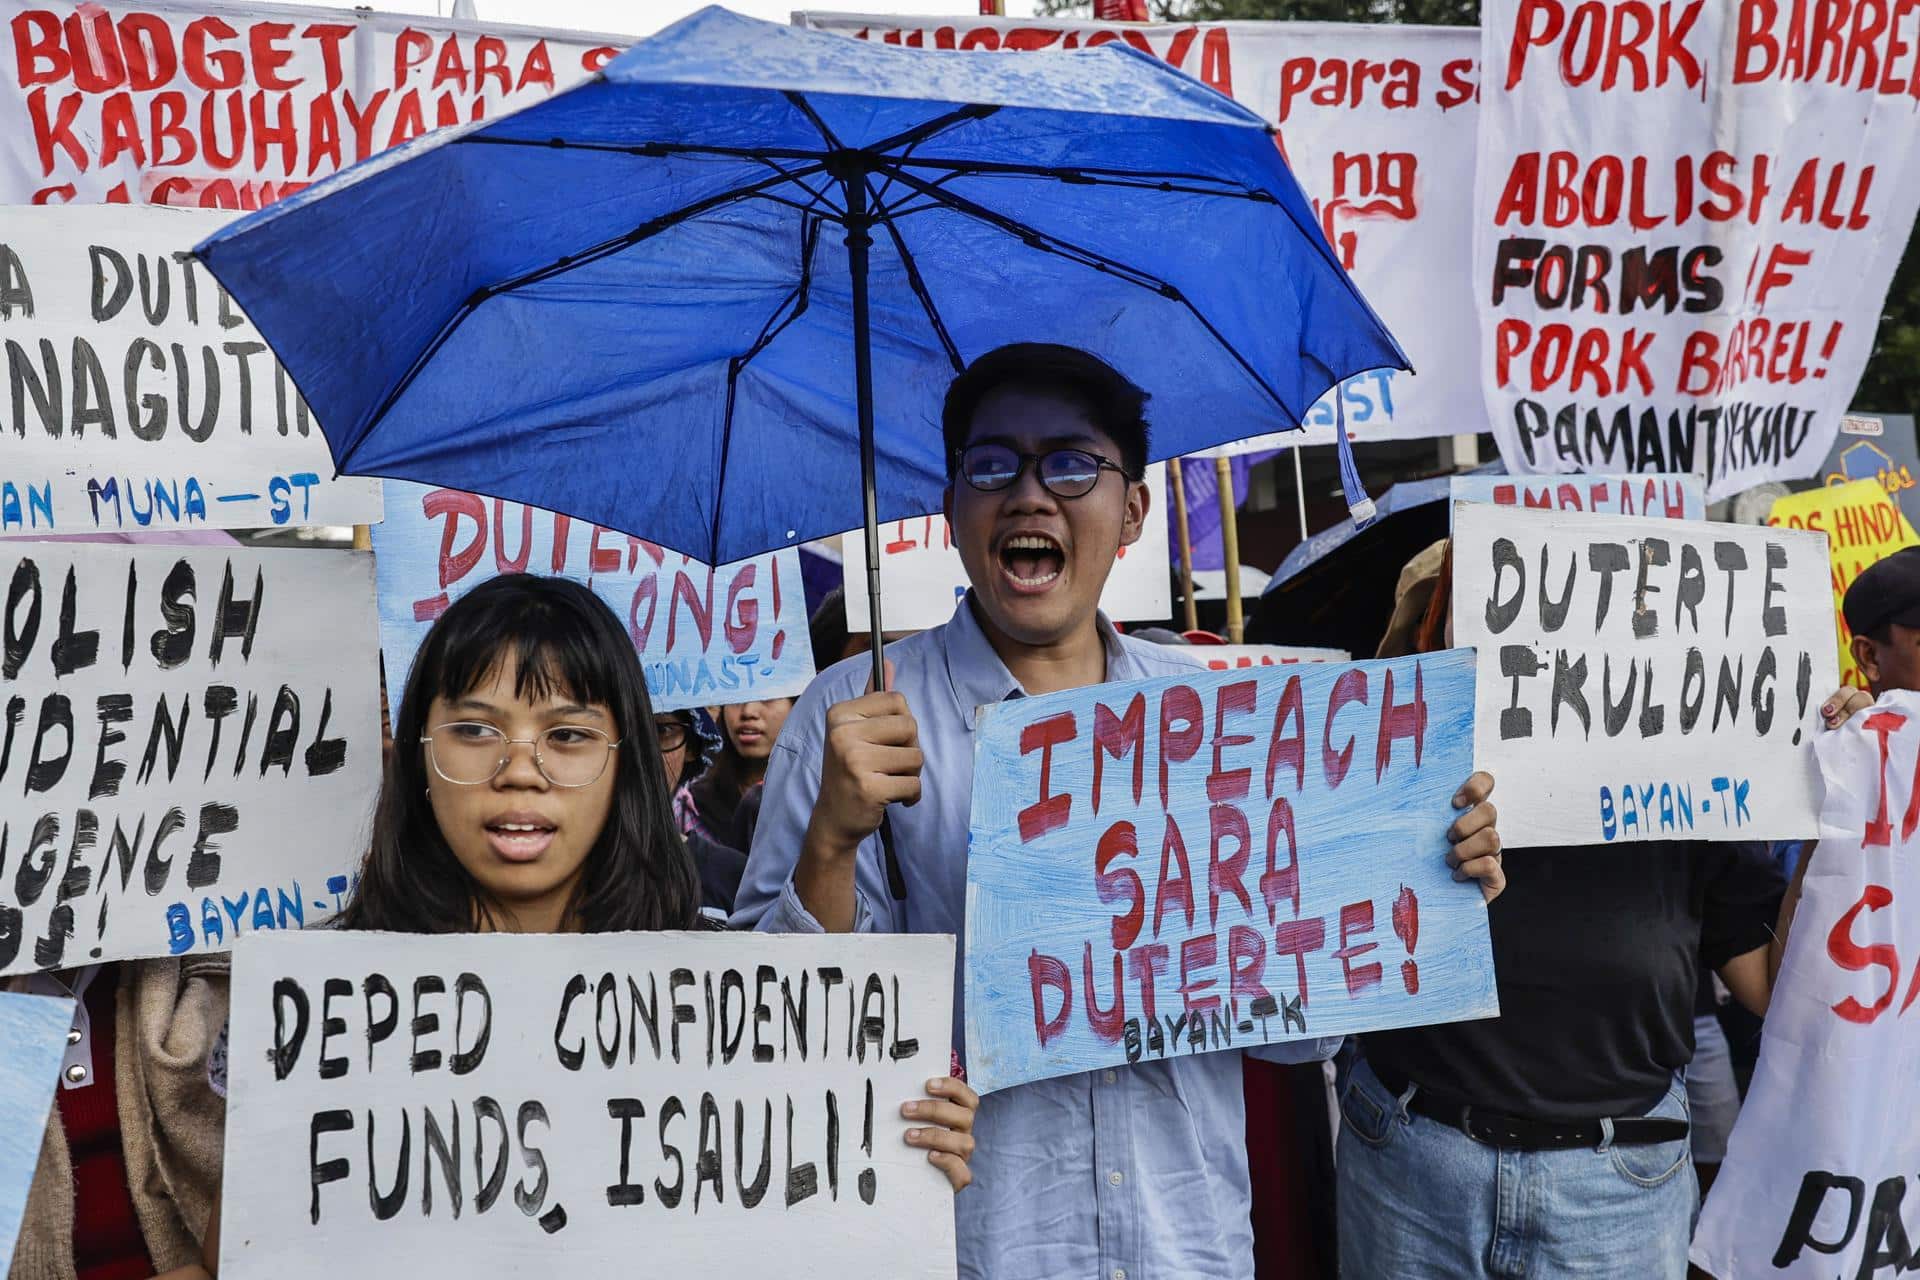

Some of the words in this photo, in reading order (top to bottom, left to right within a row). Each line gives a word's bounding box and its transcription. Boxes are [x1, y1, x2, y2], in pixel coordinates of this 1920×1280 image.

[11, 6, 357, 93] BUDGET
[394, 26, 555, 97] PARA
[1279, 57, 1421, 123] para
[1435, 58, 1480, 112] s
[1780, 157, 1875, 230] ALL
[1492, 237, 1723, 315] FORMS
[1496, 319, 1656, 398] PORK
[1834, 501, 1904, 547] HINDI
[1486, 537, 1789, 640] DUTERTE
[1500, 640, 1813, 746] IKULONG!
[1017, 658, 1428, 844] IMPEACH
[1601, 776, 1751, 841] BAYAN-TK
[166, 868, 362, 955] BAYAN-T
[1094, 797, 1301, 951] SARA
[1028, 882, 1420, 1050] DUTERTE!
[266, 971, 494, 1081] DEPED
[554, 964, 920, 1072] CONFIDENTIAL
[606, 1077, 878, 1215] ISAULI!
